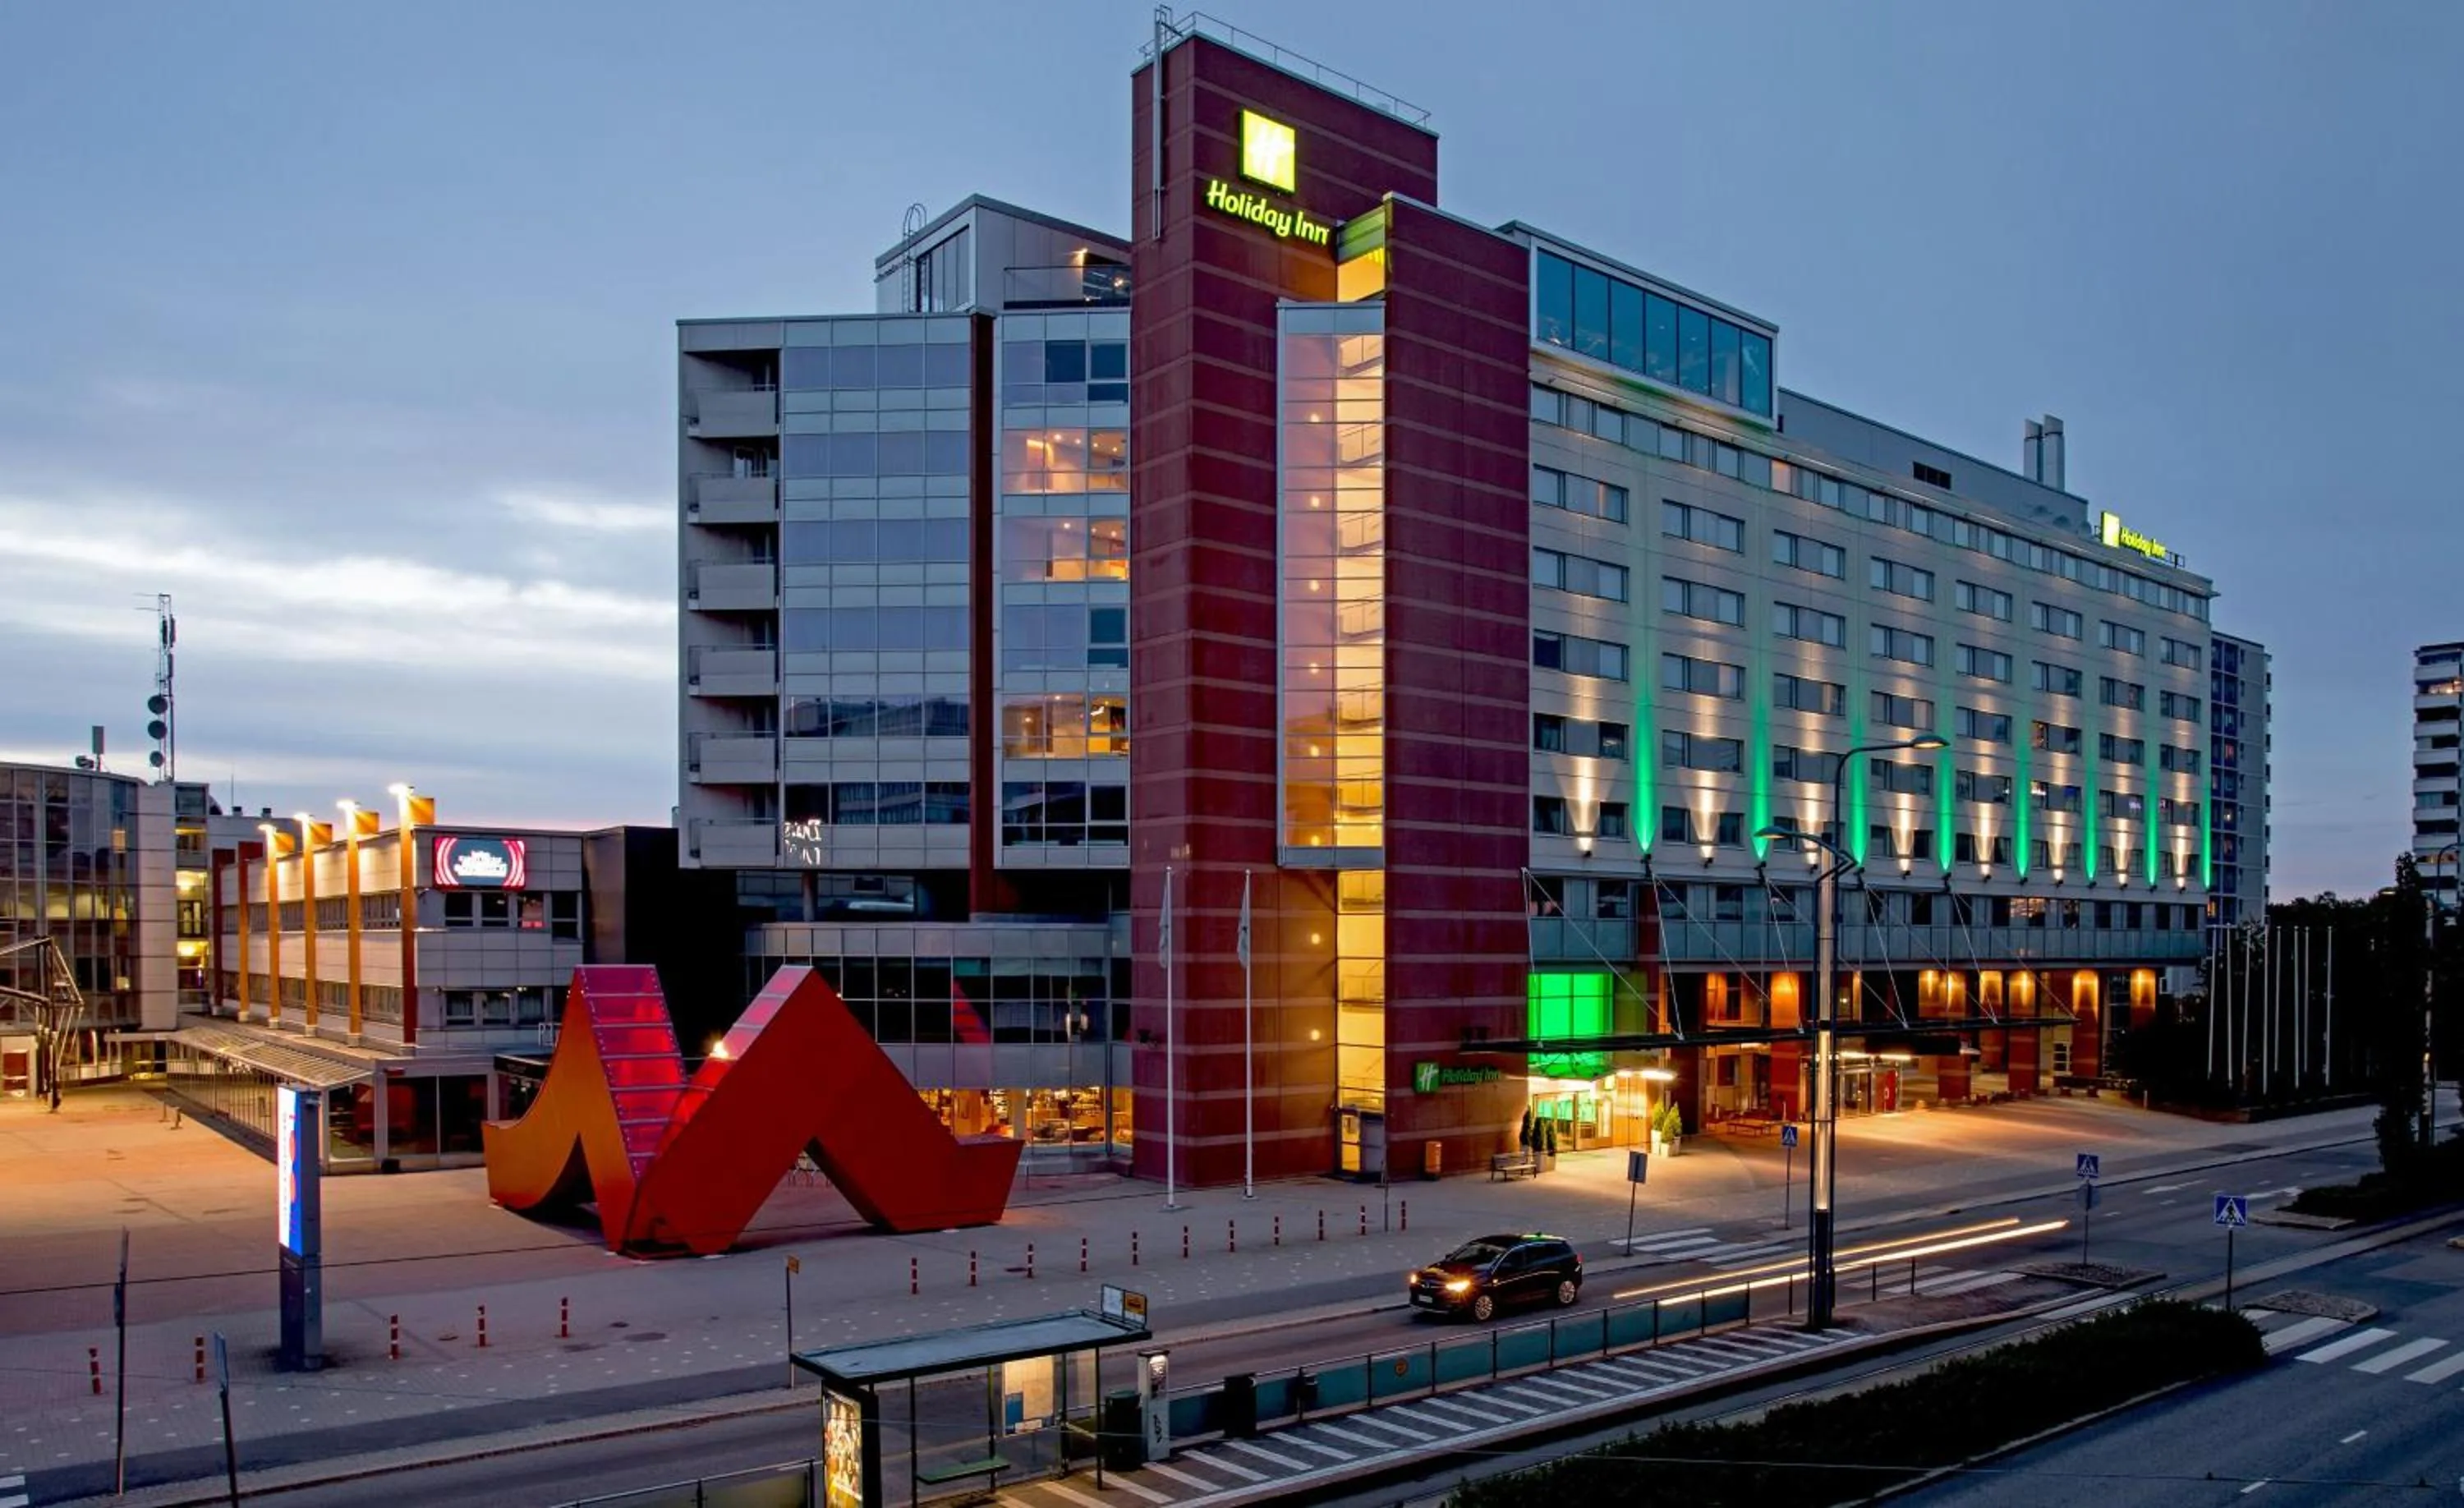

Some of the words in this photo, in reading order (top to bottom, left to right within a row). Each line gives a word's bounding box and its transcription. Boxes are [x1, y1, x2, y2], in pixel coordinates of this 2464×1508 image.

[1207, 179, 1292, 237] Holiday
[1295, 210, 1330, 246] Inn
[2121, 527, 2150, 558] Holiday
[2152, 538, 2165, 558] Inn
[1442, 1068, 1483, 1086] Holiday
[1484, 1068, 1501, 1081] Inn
